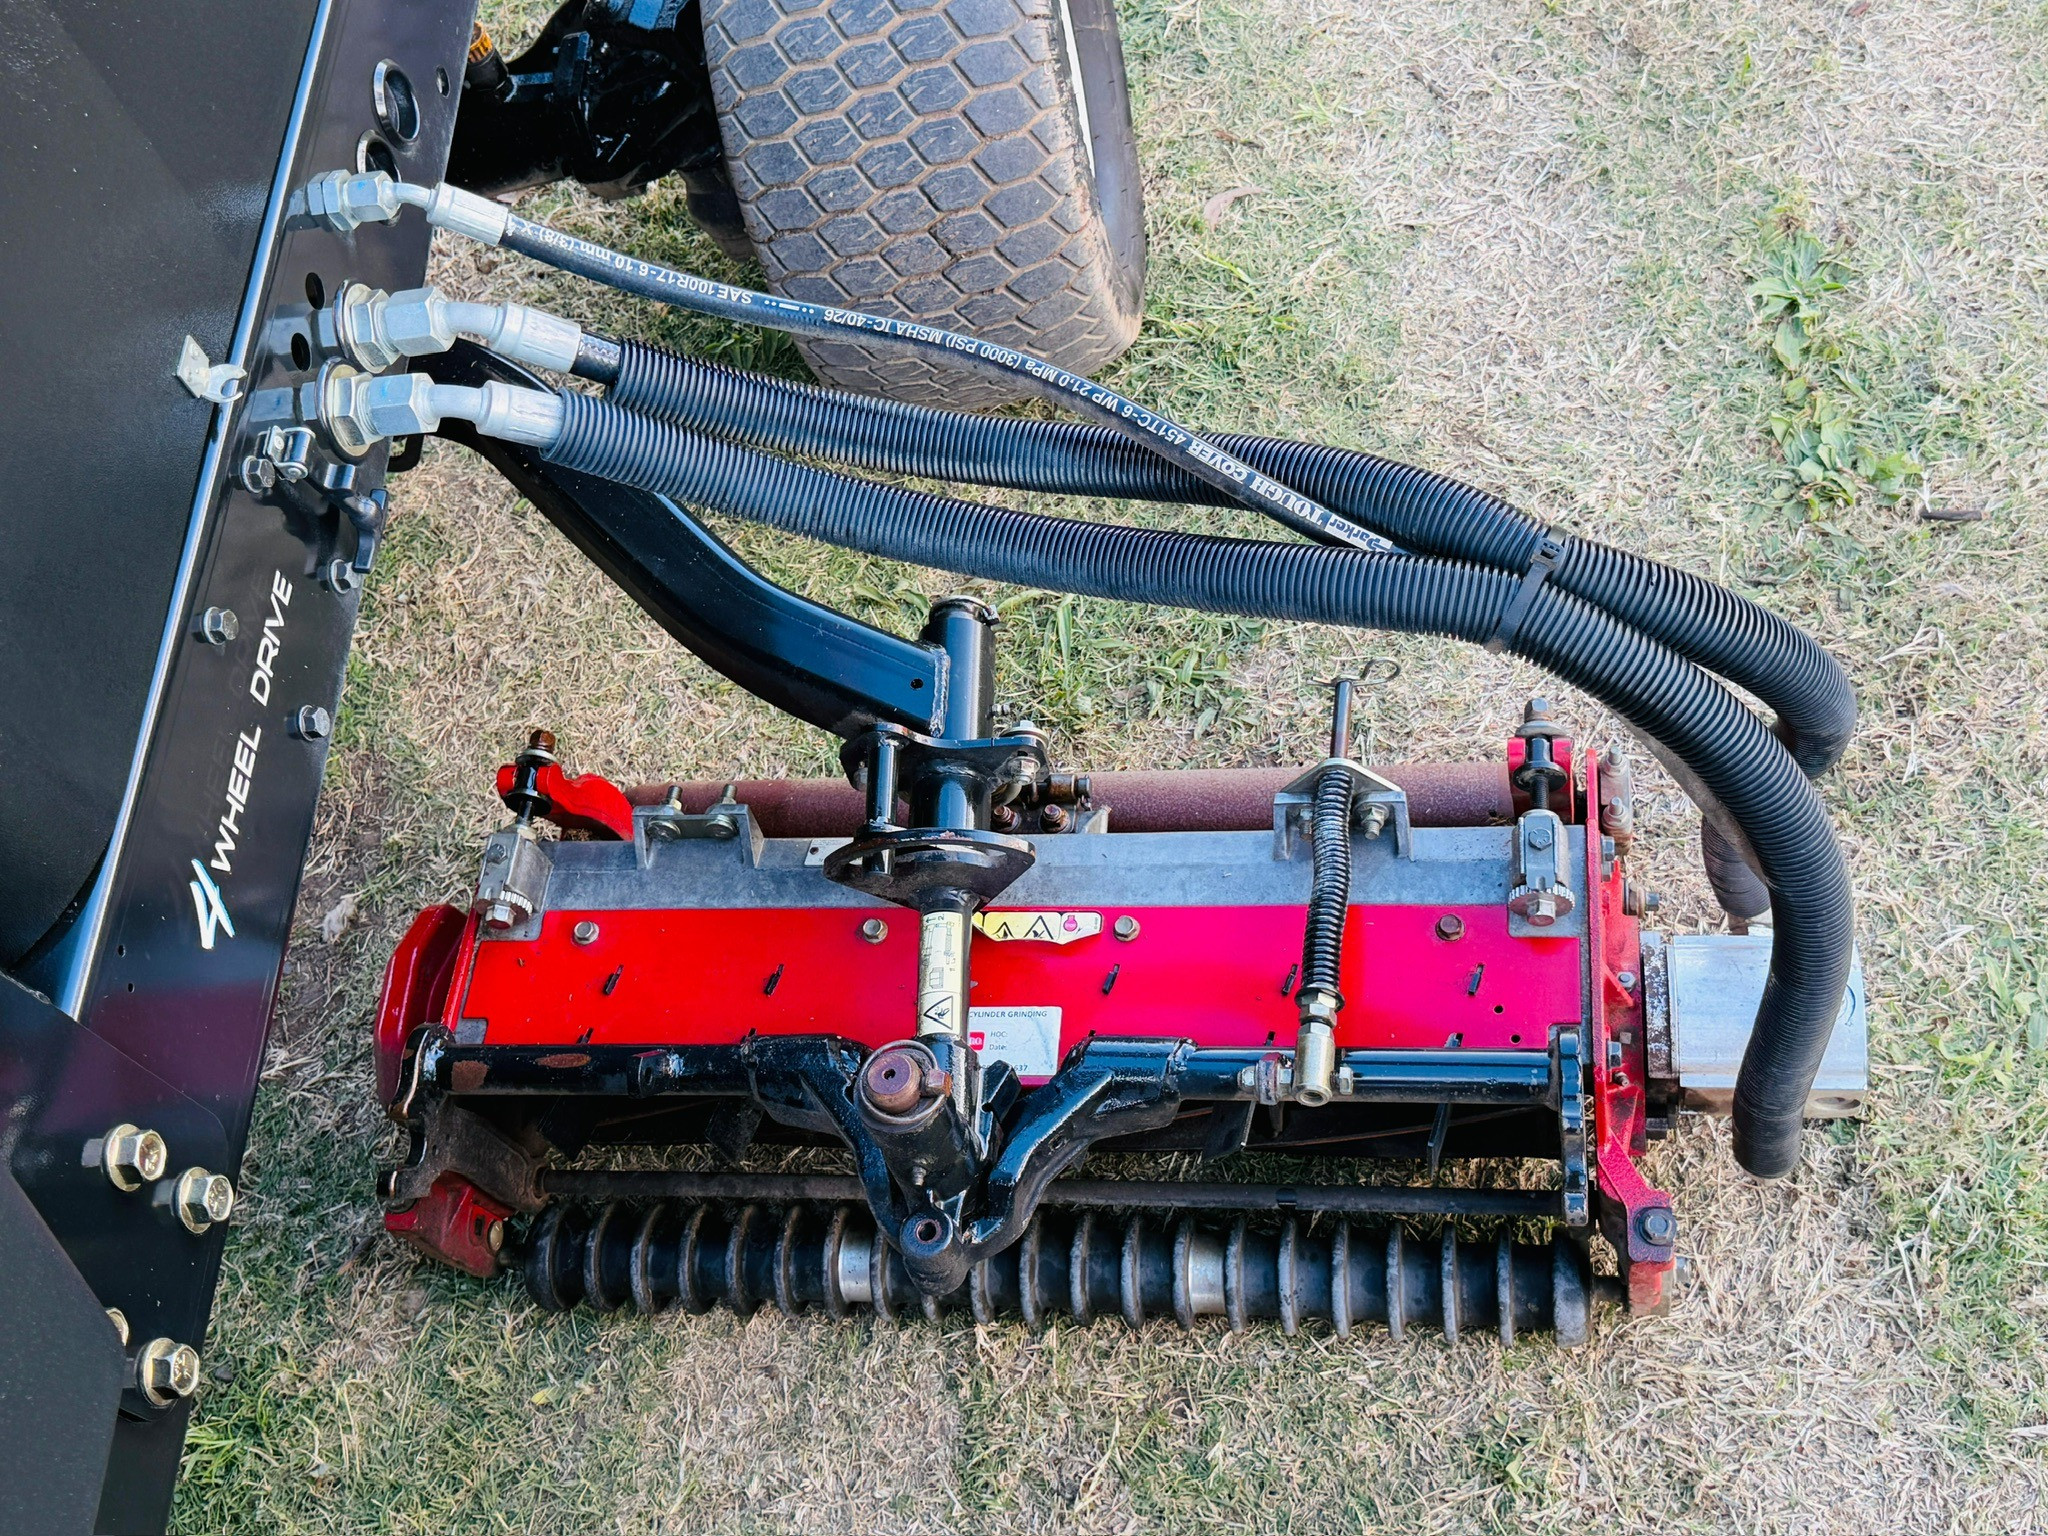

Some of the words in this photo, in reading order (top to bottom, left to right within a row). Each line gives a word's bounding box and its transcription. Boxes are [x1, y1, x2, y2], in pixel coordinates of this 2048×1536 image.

[579, 241, 612, 262] mm
[614, 255, 634, 272] 10
[638, 263, 716, 295] 100R17-6
[718, 284, 754, 305] SAE
[823, 309, 893, 333] IC-40/26
[896, 321, 942, 344] MSHA
[946, 333, 978, 354] PSI)
[979, 343, 1022, 370] (3000
[1025, 360, 1059, 382] MPa
[1091, 391, 1119, 412] WP
[1121, 404, 1187, 446] 451TC-6
[1186, 439, 1250, 485] COVER
[1249, 475, 1324, 526] TOUGH
[1329, 518, 1383, 551] Parker
[249, 569, 294, 705] DRIVE
[211, 726, 262, 873] WHEEL
[190, 859, 234, 949] 4
